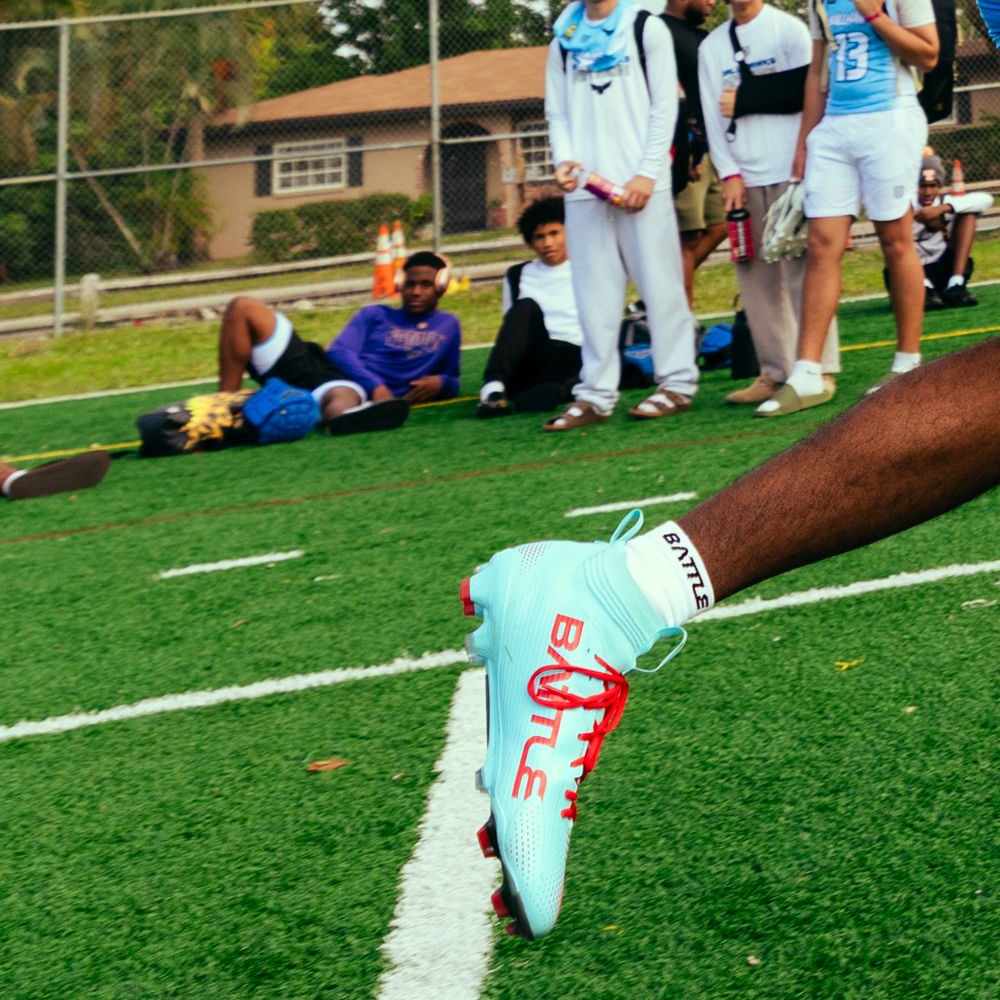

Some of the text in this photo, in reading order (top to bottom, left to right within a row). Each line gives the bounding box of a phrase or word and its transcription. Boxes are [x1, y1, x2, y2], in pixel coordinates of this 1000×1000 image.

[834, 30, 869, 82] 13
[663, 533, 709, 609] BATTLE
[512, 613, 584, 800] BATTLE
